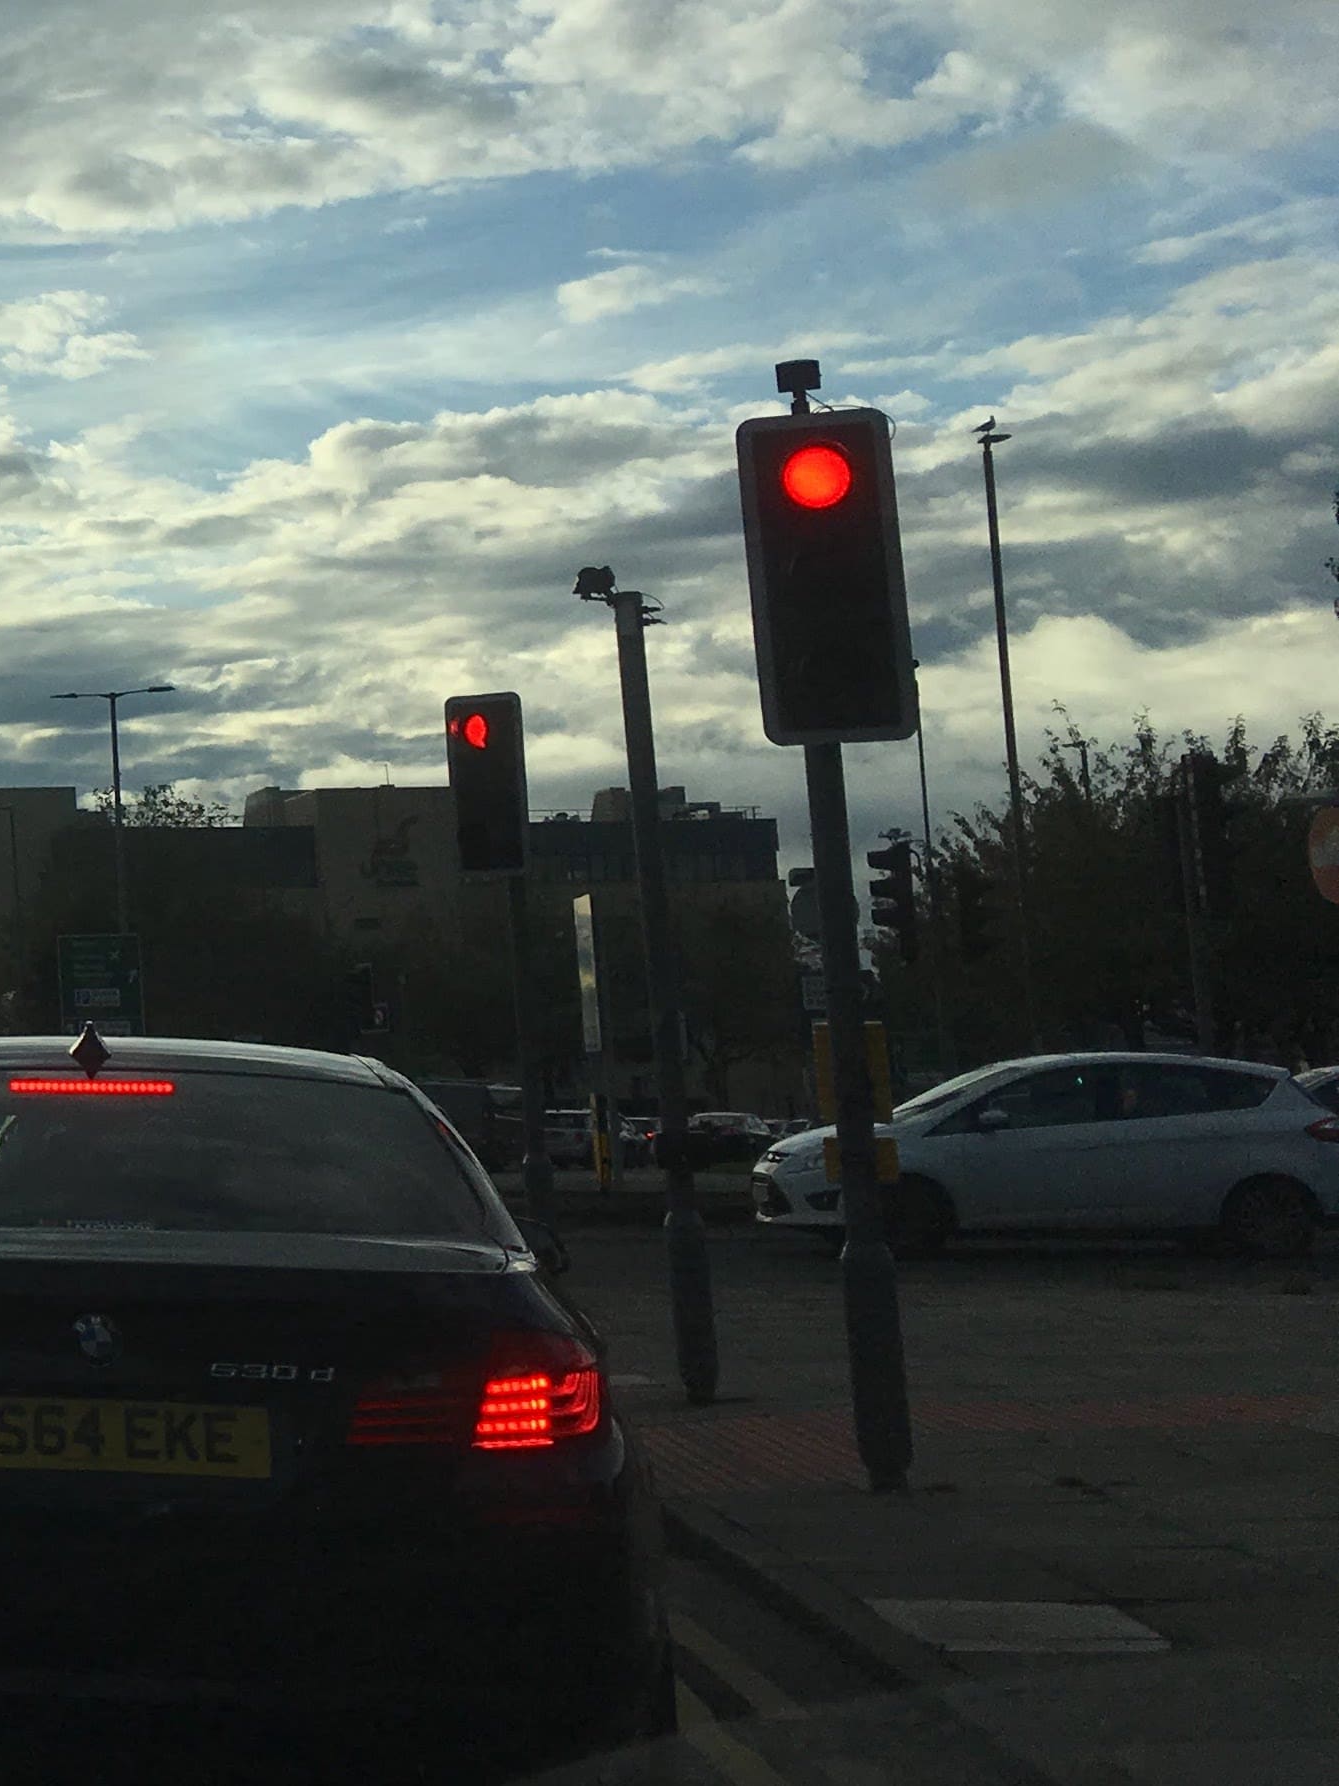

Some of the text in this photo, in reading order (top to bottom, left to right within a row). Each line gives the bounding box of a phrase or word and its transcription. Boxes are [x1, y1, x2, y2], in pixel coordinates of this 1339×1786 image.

[210, 1362, 335, 1382] 530 d
[124, 1405, 241, 1463] EKE
